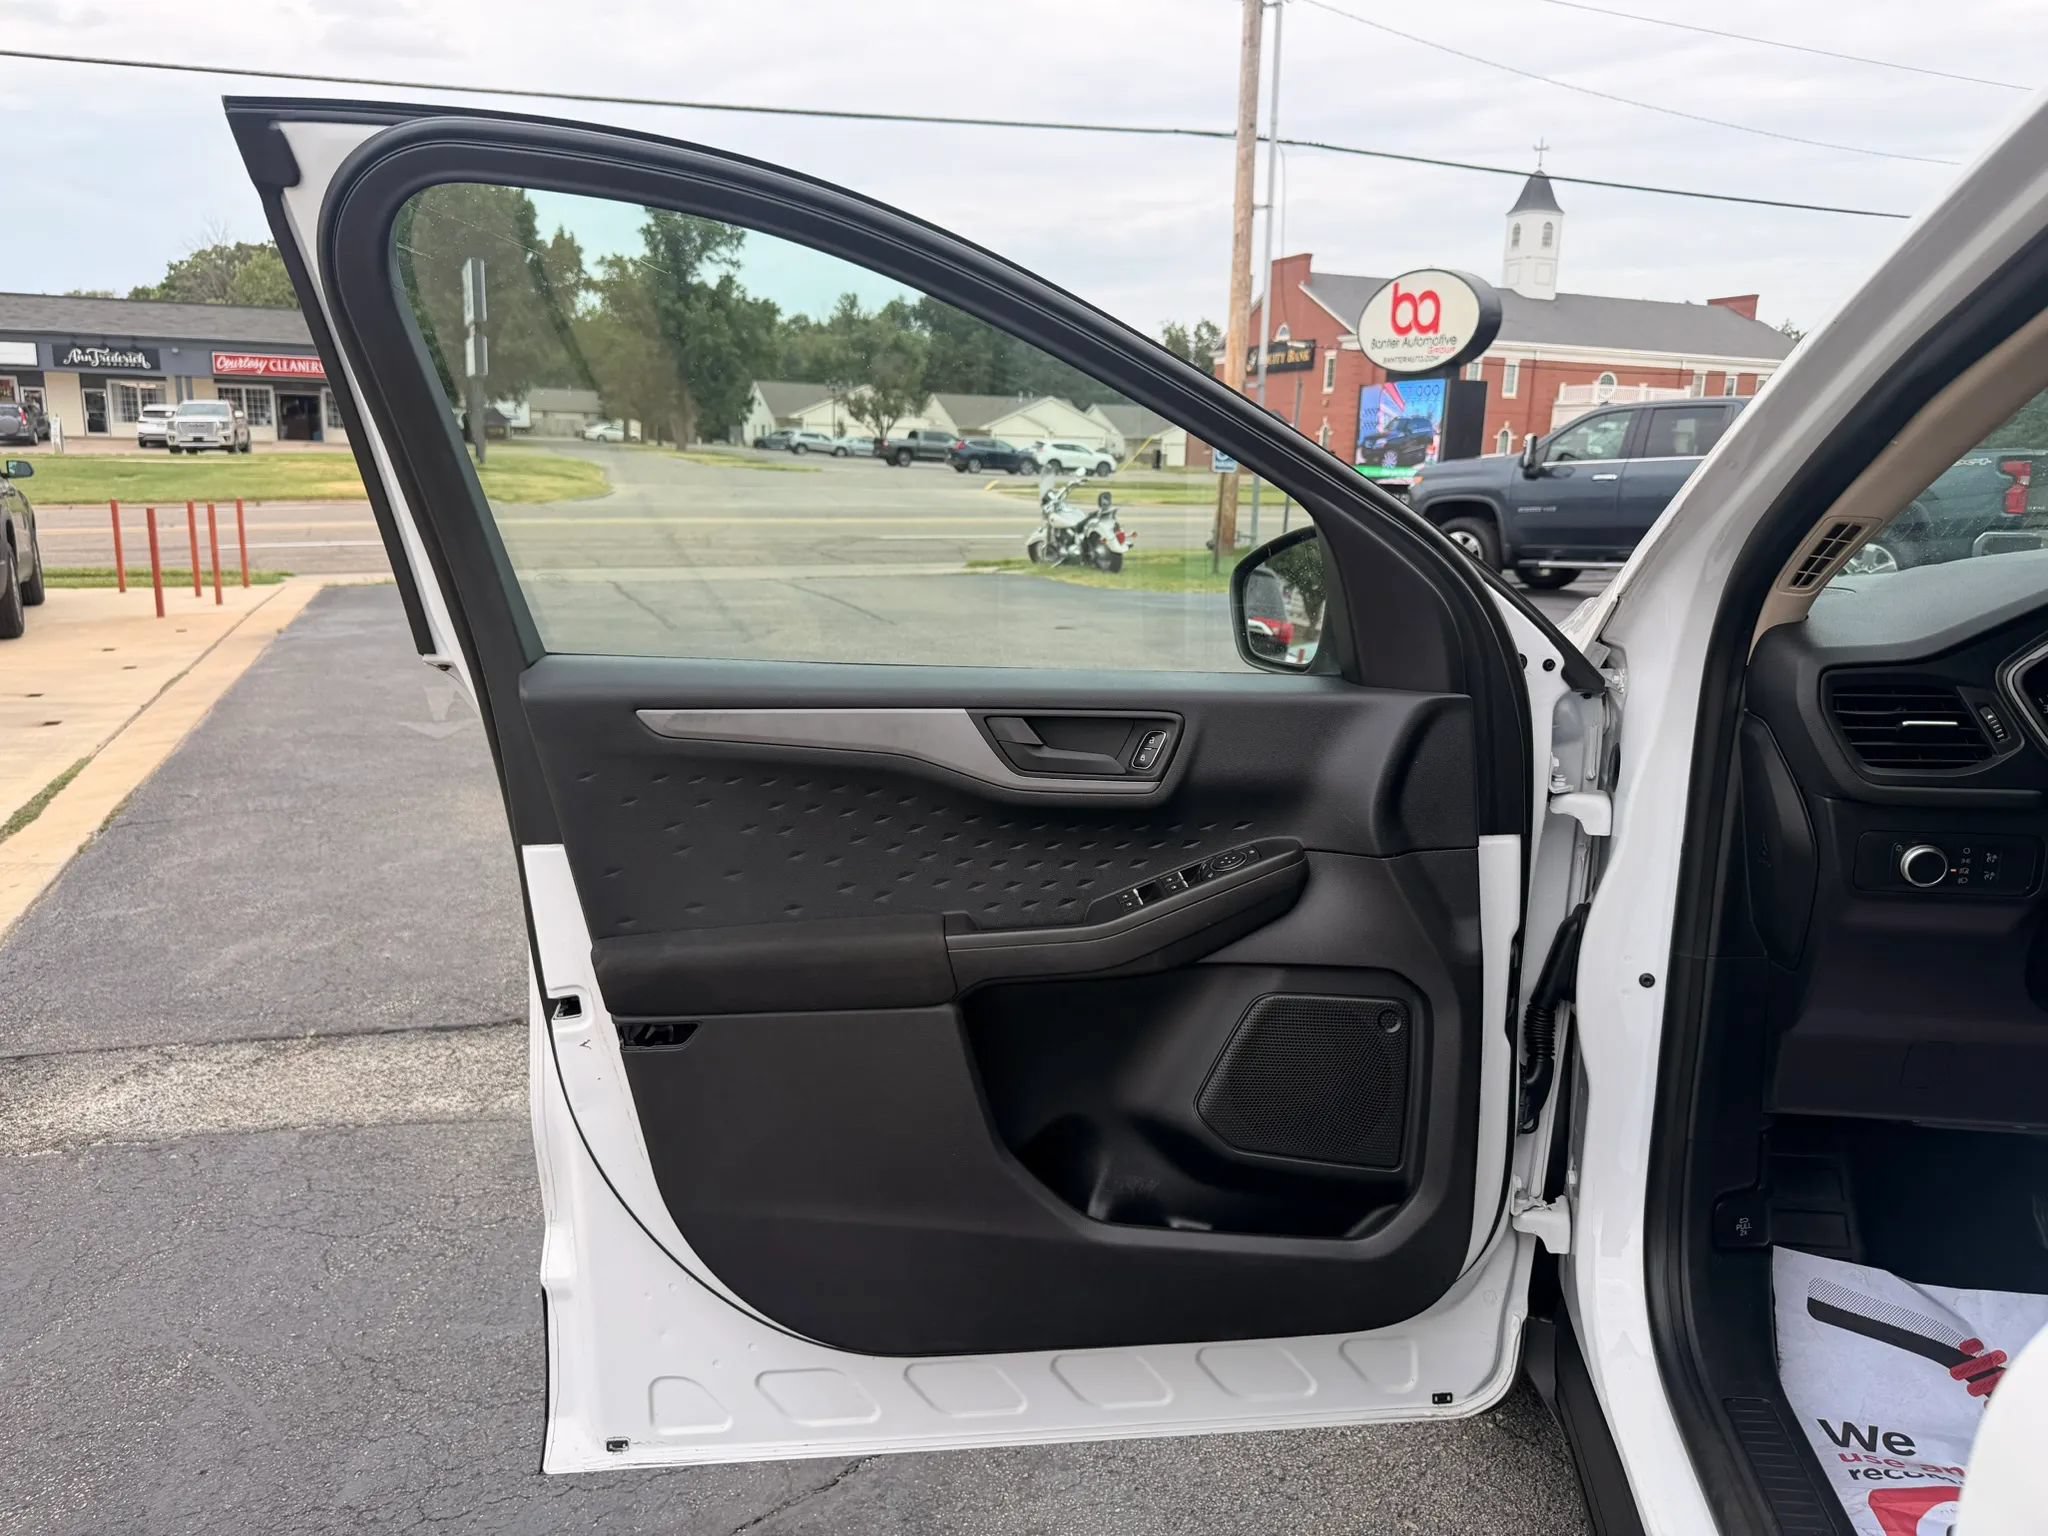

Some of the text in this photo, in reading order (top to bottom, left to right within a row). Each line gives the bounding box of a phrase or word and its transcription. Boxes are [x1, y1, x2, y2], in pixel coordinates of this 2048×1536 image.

[1391, 282, 1441, 335] ba
[1402, 333, 1457, 348] Automotive
[216, 356, 268, 375] Courtesy
[1817, 1418, 1916, 1456] We
[1838, 1453, 1905, 1468] use
